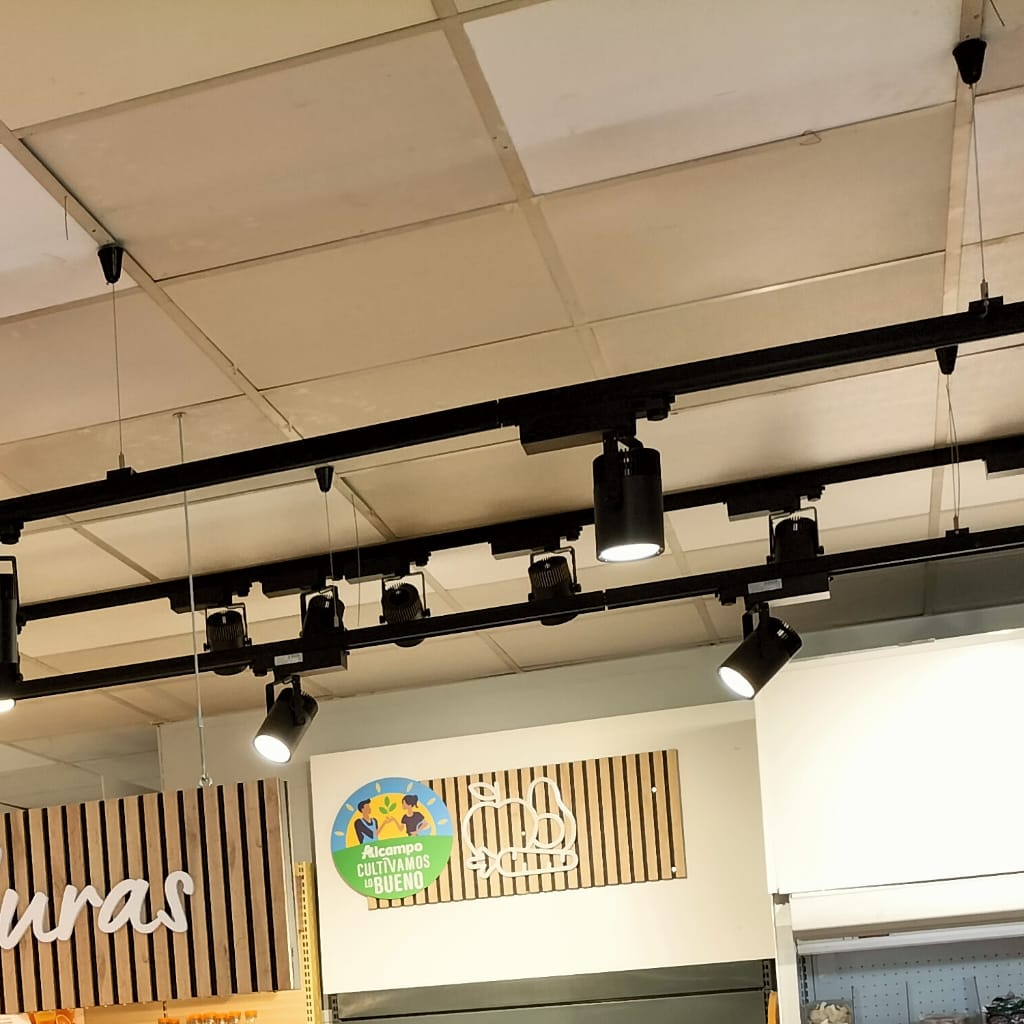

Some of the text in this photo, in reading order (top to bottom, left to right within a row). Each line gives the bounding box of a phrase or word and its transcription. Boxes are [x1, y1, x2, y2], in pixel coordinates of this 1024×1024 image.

[361, 842, 423, 859] Alcampo
[357, 854, 430, 877] CULTIVAMOS
[374, 871, 424, 894] BUENO
